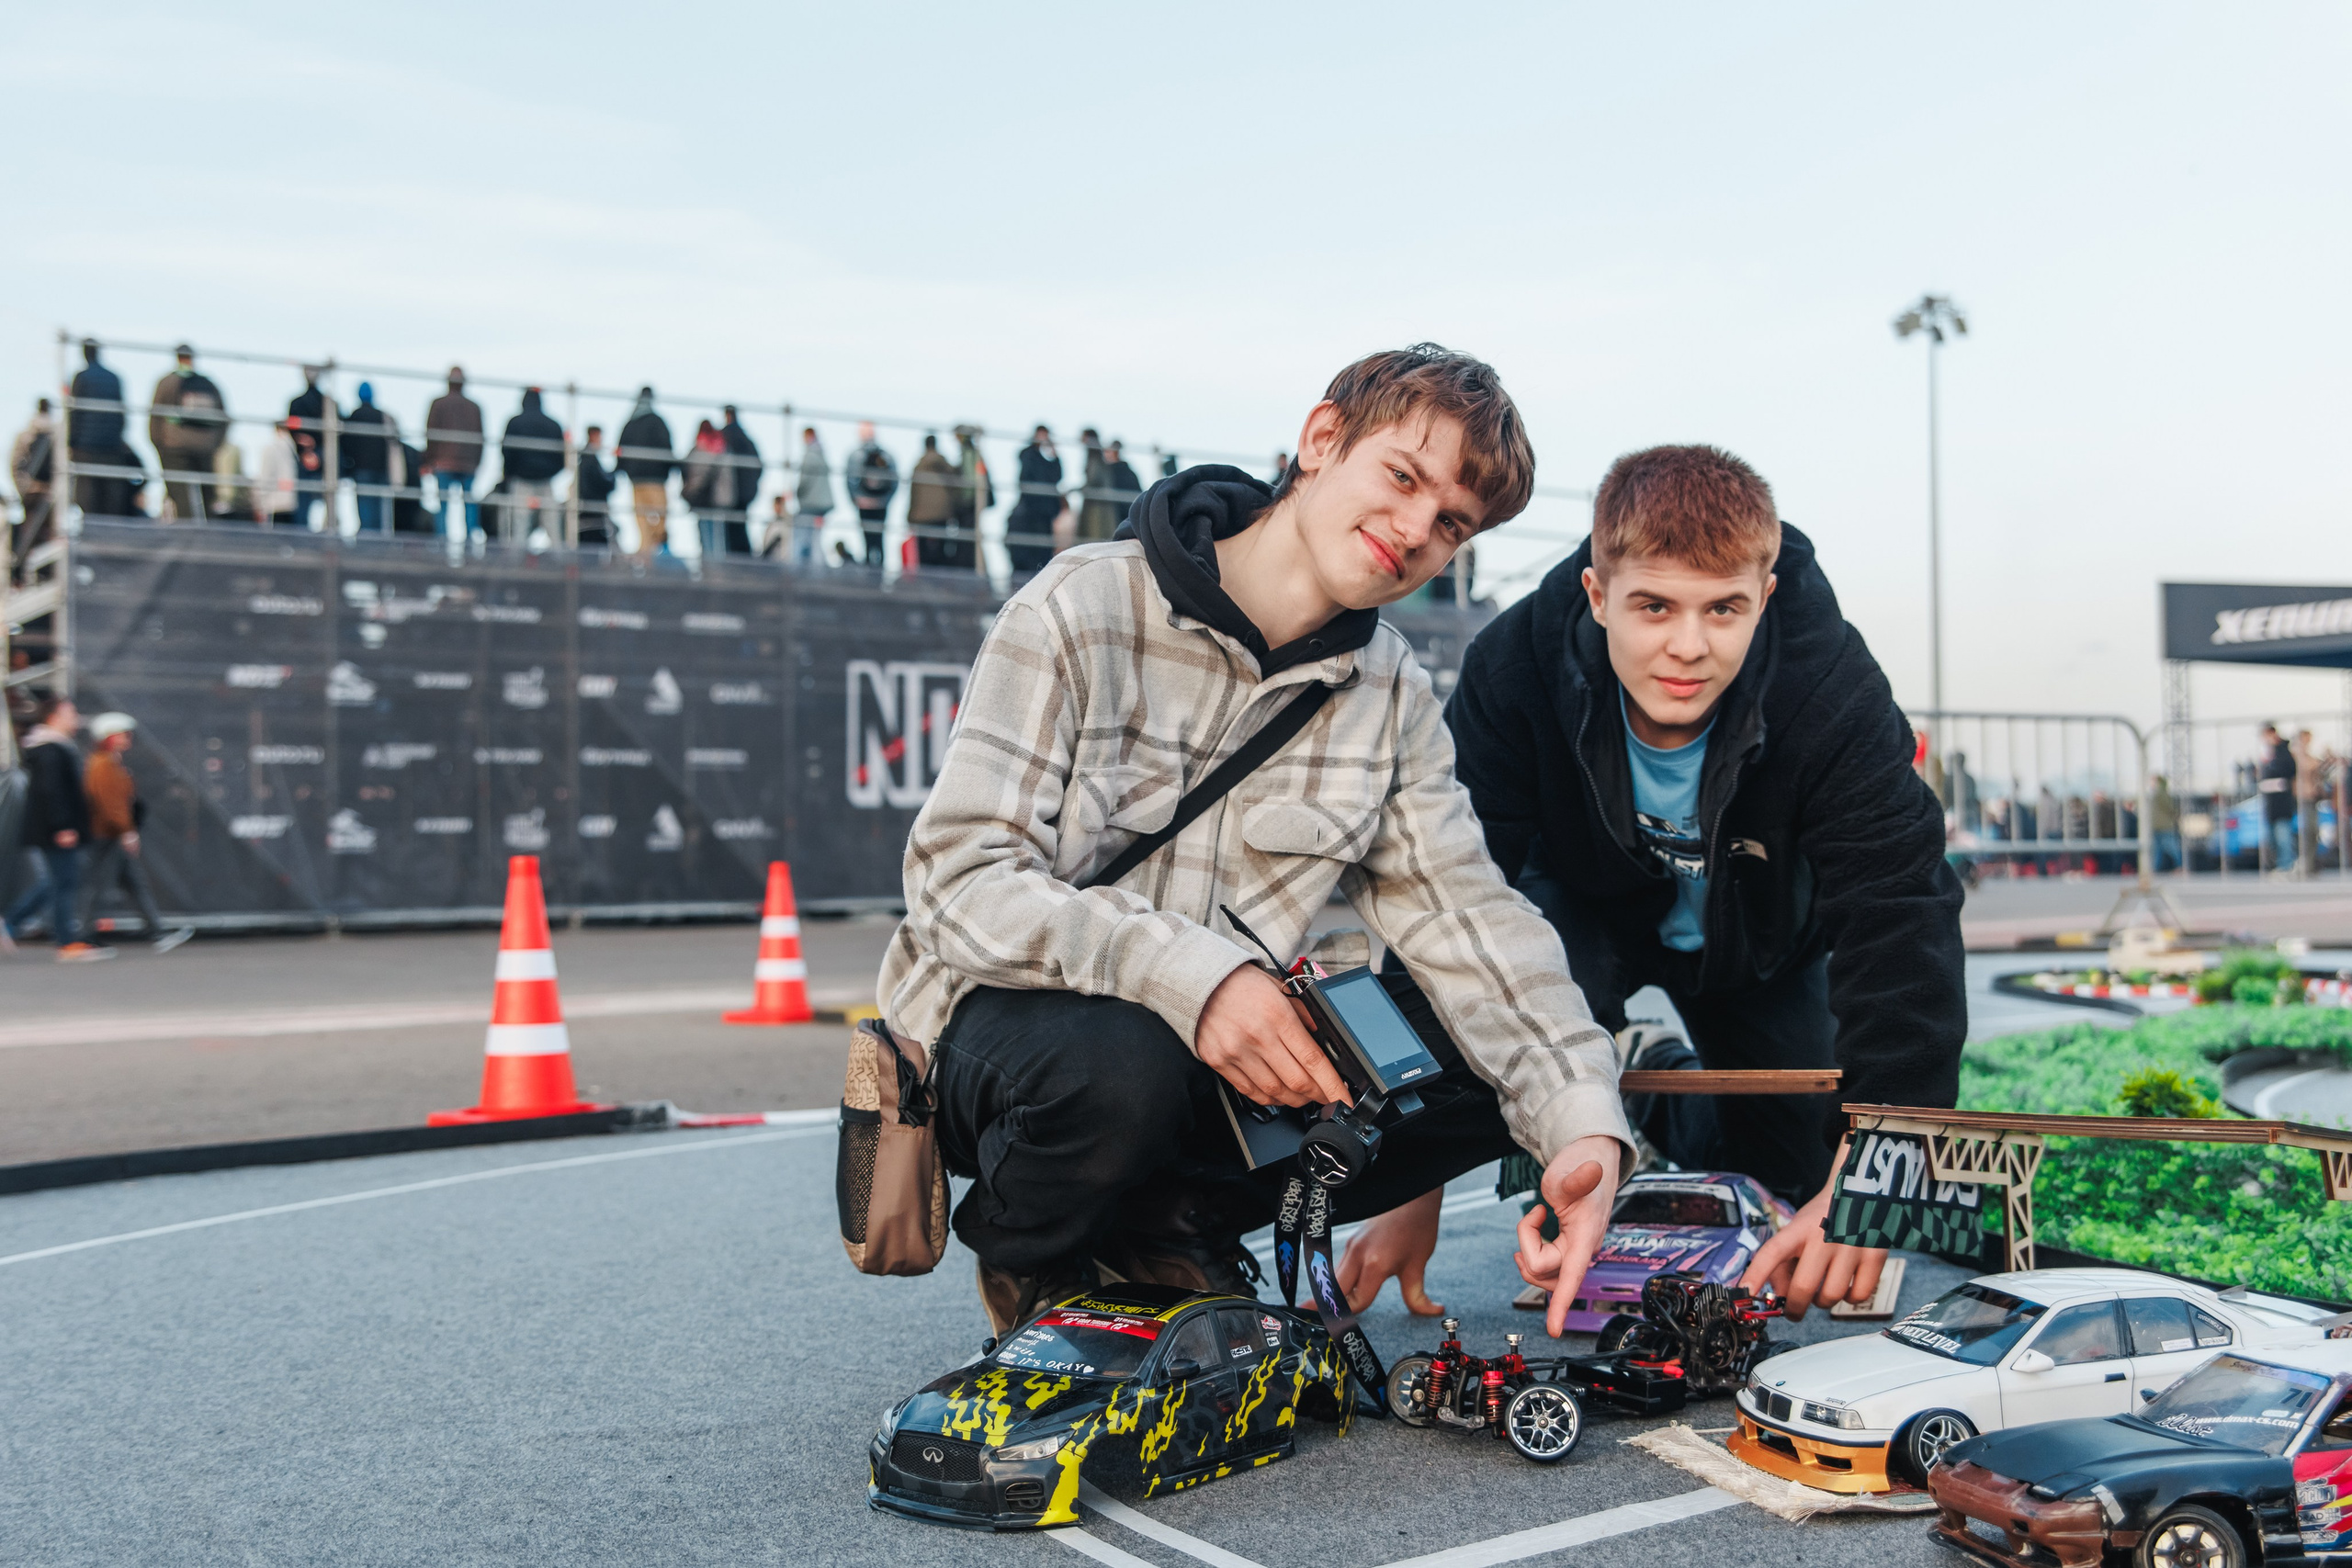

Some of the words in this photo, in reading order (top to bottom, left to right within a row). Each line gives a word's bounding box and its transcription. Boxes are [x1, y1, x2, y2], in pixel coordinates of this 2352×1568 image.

[1897, 1325, 1930, 1339] NEXT
[1921, 1332, 1962, 1354] LEVEL
[1017, 1357, 1041, 1367] IT'S
[1046, 1359, 1084, 1371] OKAY
[2279, 1388, 2312, 1407] 71
